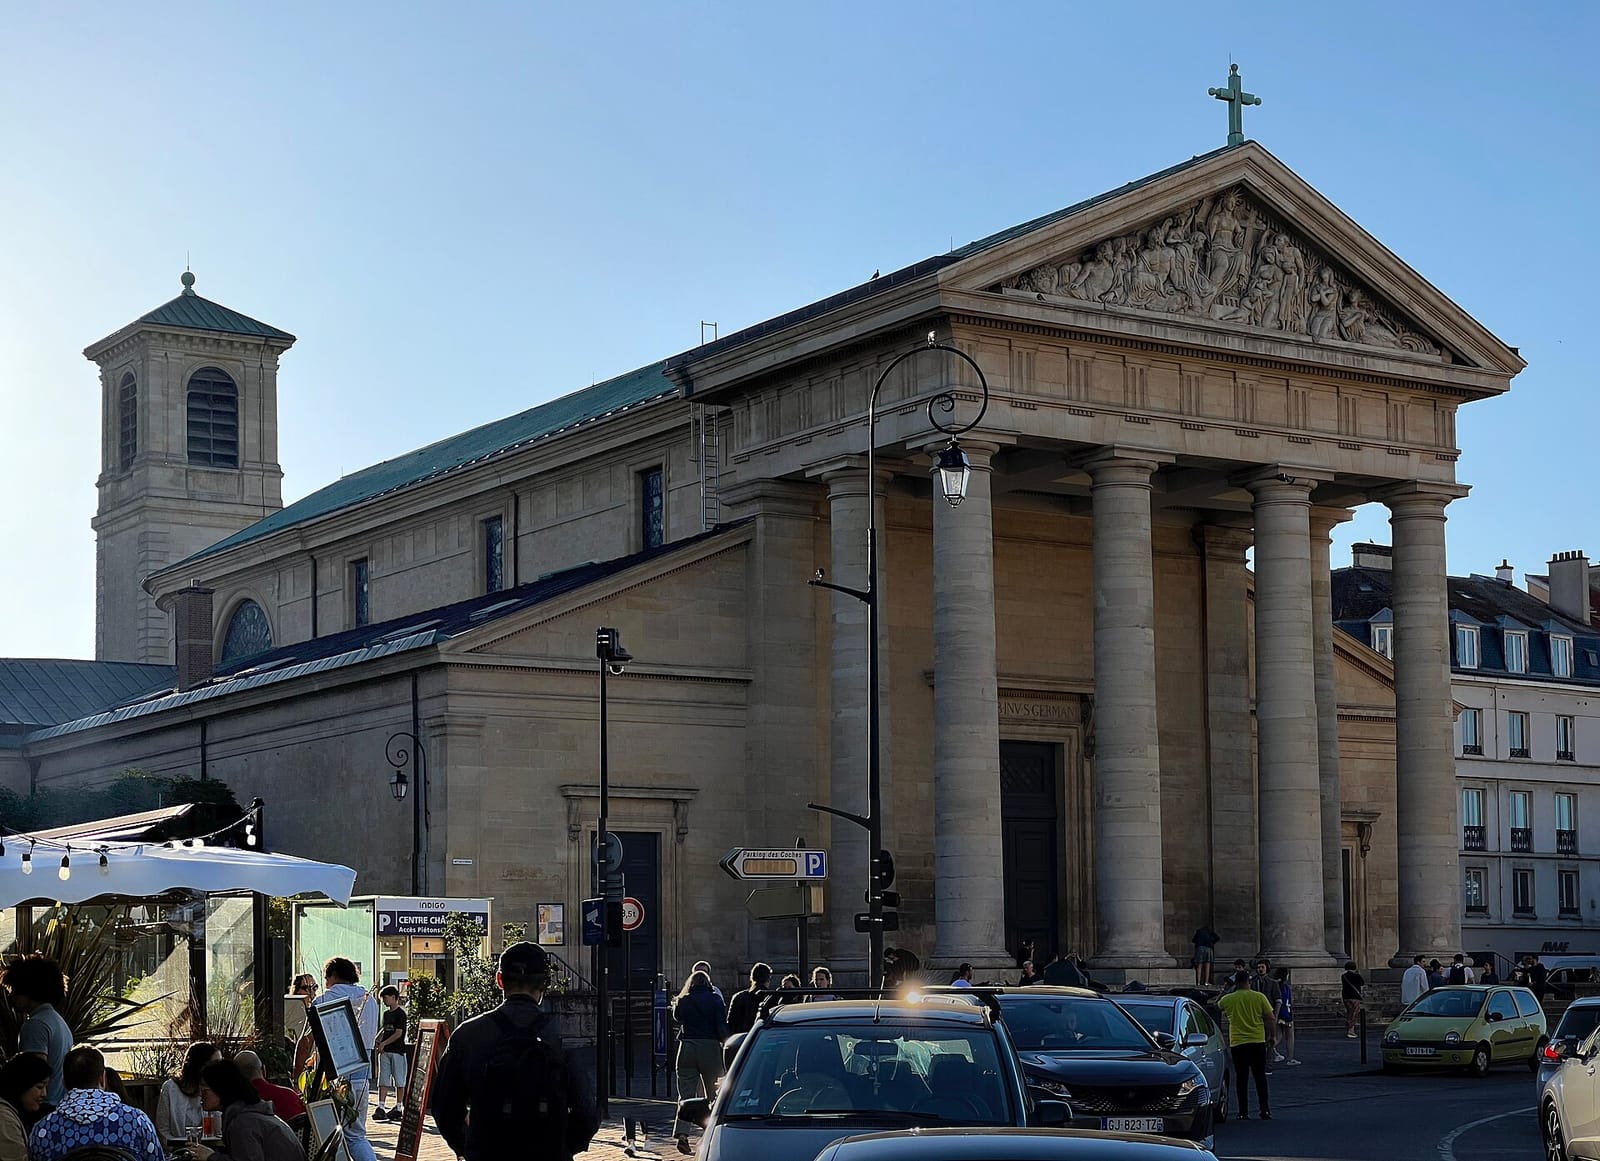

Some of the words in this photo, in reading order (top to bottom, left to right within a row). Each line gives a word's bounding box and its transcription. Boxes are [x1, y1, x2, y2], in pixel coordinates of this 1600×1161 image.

[742, 851, 765, 859] Parking
[809, 854, 821, 875] P
[398, 915, 428, 925] CENTRE
[429, 913, 447, 925] CHÂ
[398, 926, 417, 934] Accès
[417, 926, 442, 934] Piétons
